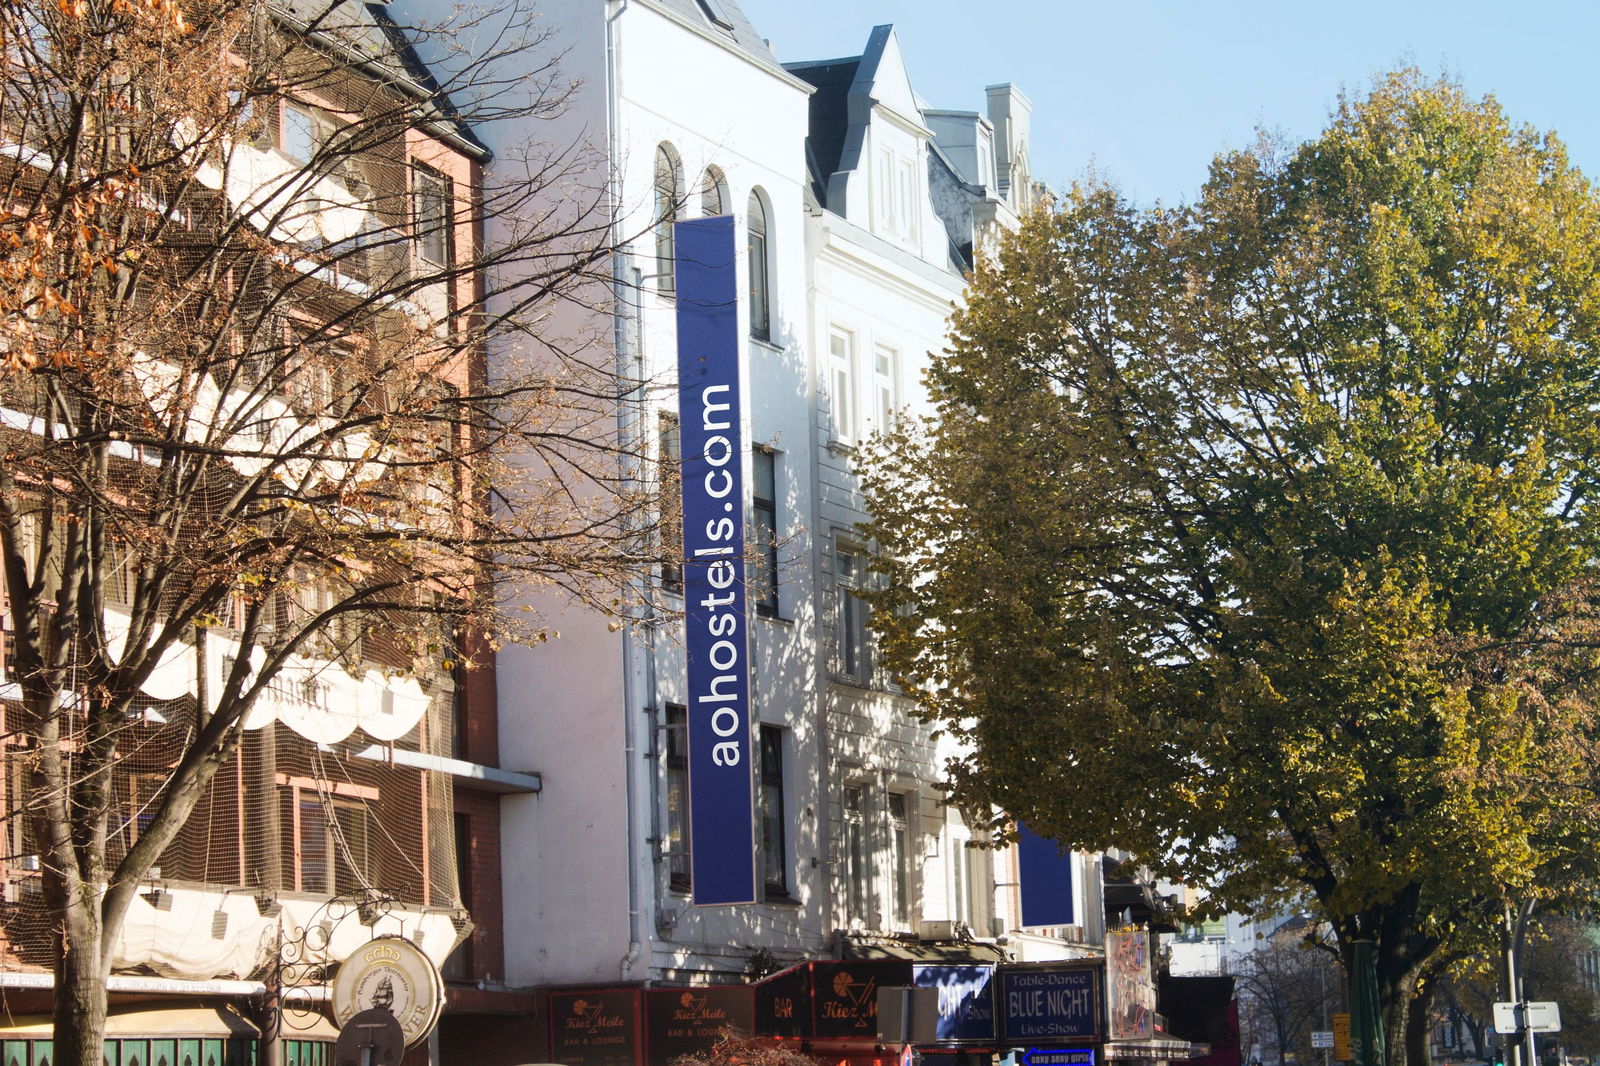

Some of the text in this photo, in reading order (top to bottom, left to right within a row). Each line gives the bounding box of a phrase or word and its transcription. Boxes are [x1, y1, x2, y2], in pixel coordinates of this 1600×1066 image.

[694, 383, 741, 768] aohostels.com
[1012, 974, 1087, 986] Table-Dance
[774, 997, 793, 1018] BAR
[821, 1001, 858, 1019] Kiez
[967, 1004, 992, 1021] Show
[1009, 988, 1090, 1020] BLUE NIGHT
[667, 1028, 685, 1038] BAR
[1020, 1023, 1080, 1035] Live-Show
[1031, 1055, 1049, 1064] sexy
[1051, 1054, 1069, 1063] sexy
